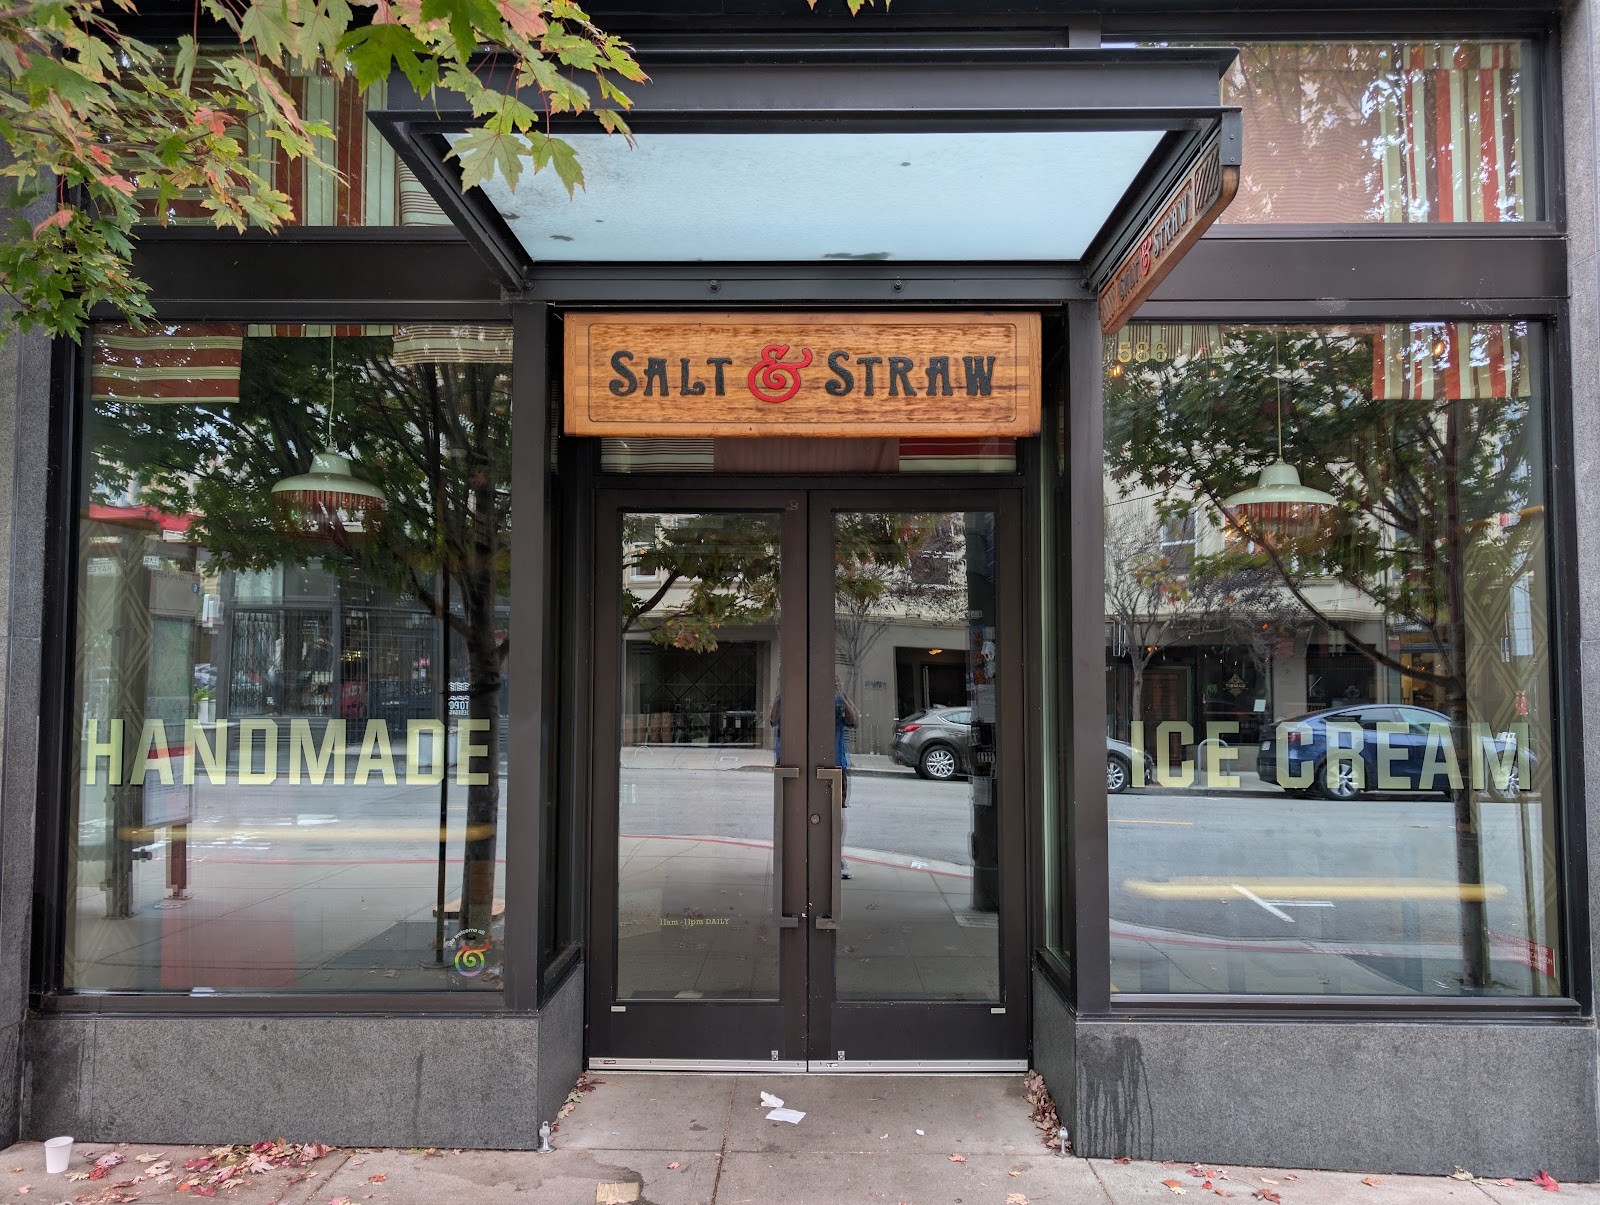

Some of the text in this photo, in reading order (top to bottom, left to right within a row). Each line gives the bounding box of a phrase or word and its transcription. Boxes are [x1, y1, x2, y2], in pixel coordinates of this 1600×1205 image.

[1139, 240, 1152, 276] &
[1153, 196, 1187, 257] STRAW
[609, 344, 995, 402] SALT & STRAW
[1117, 341, 1168, 363] 586
[85, 718, 491, 787] HANDMADE
[1131, 720, 1531, 790] ICE CREAM
